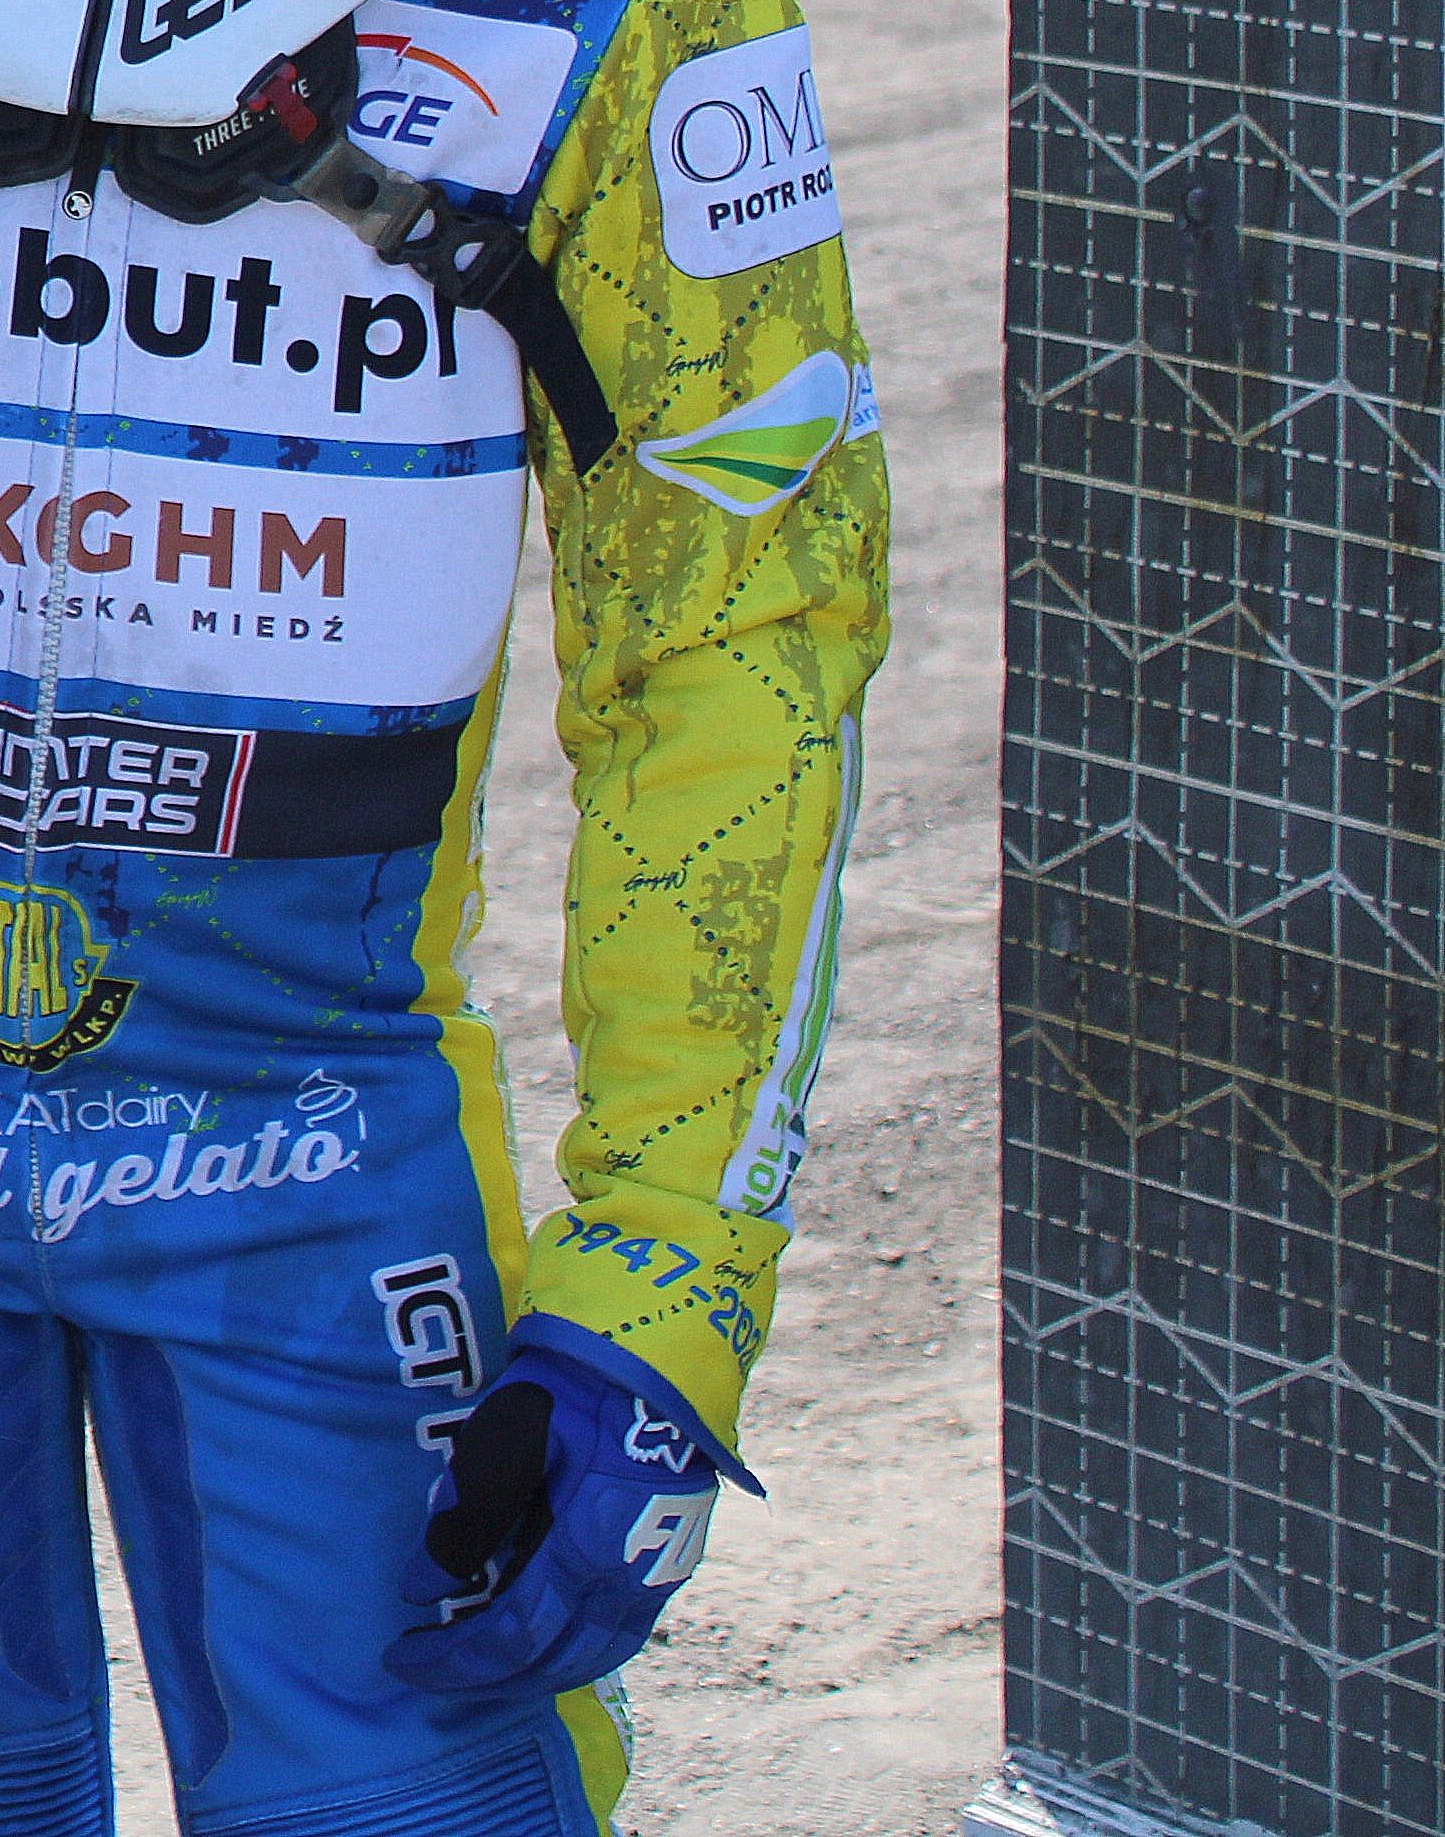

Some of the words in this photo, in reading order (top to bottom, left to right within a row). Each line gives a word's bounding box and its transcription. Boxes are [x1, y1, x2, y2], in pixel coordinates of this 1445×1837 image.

[193, 110, 252, 157] THREE
[345, 90, 454, 147] GE
[709, 181, 798, 232] PIOTR
[193, 607, 347, 646] MIEDŹ
[50, 988, 125, 1063] WLKP.
[34, 1119, 361, 1245] gelato
